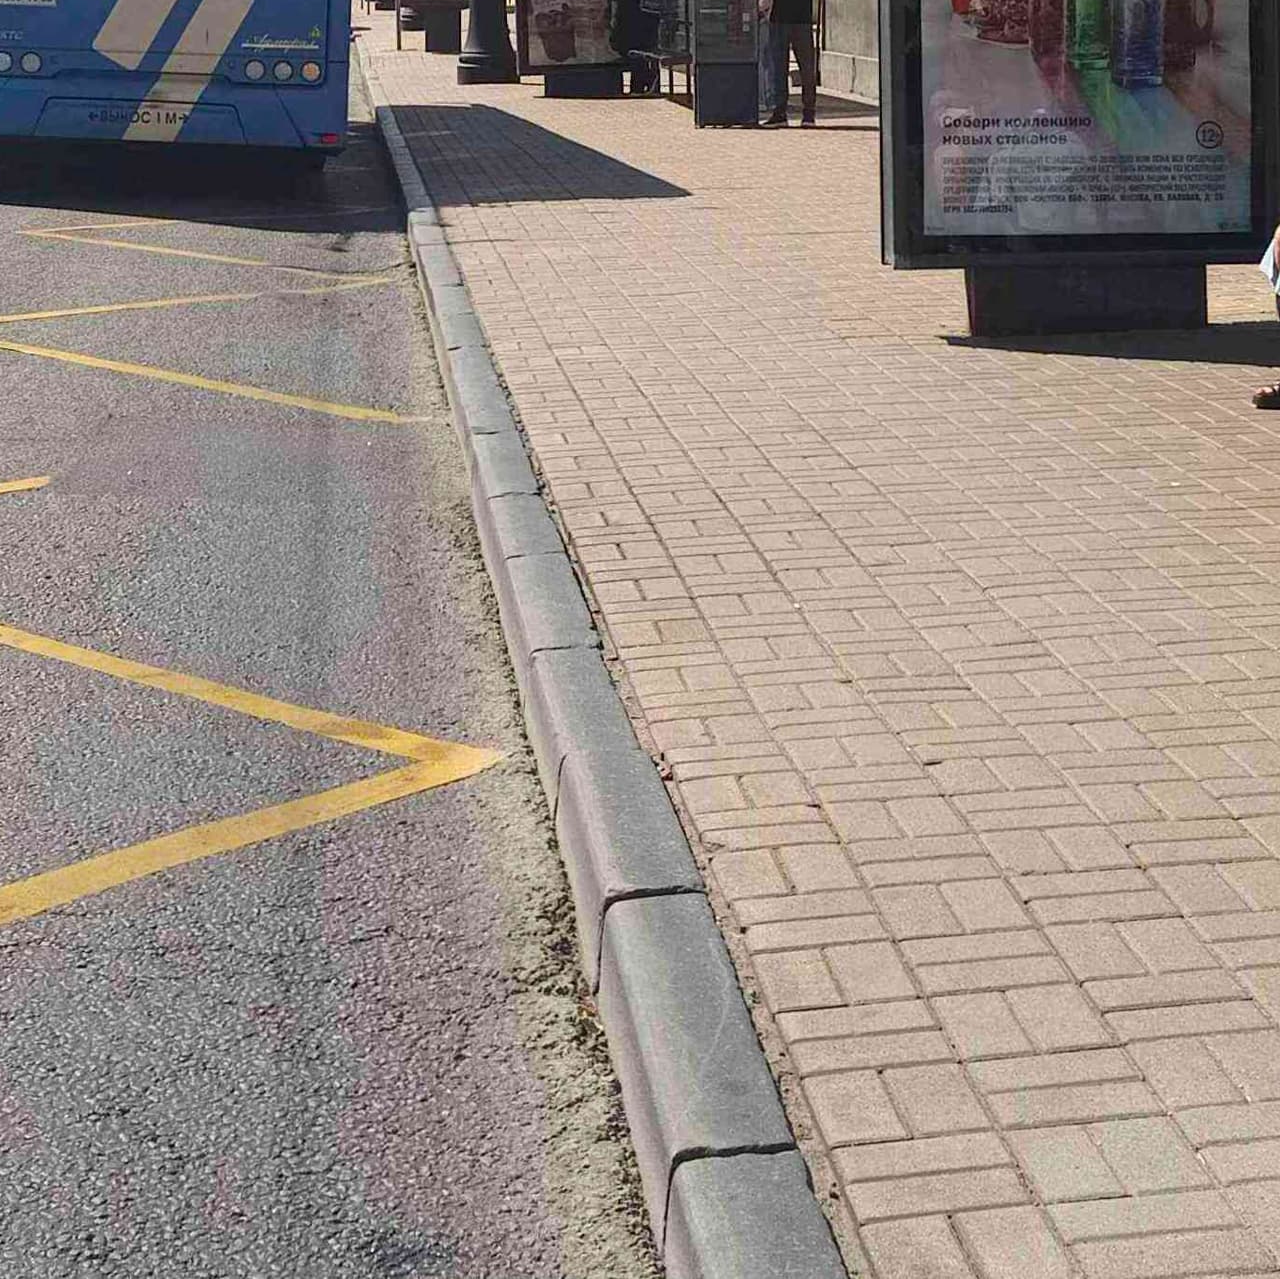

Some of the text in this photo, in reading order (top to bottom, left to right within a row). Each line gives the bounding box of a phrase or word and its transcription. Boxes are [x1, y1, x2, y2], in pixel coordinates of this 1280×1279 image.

[100, 110, 151, 125] ВЫНОС
[165, 112, 177, 125] М
[942, 115, 1092, 130] Собери коллекцию
[942, 133, 1068, 146] новых стаканов
